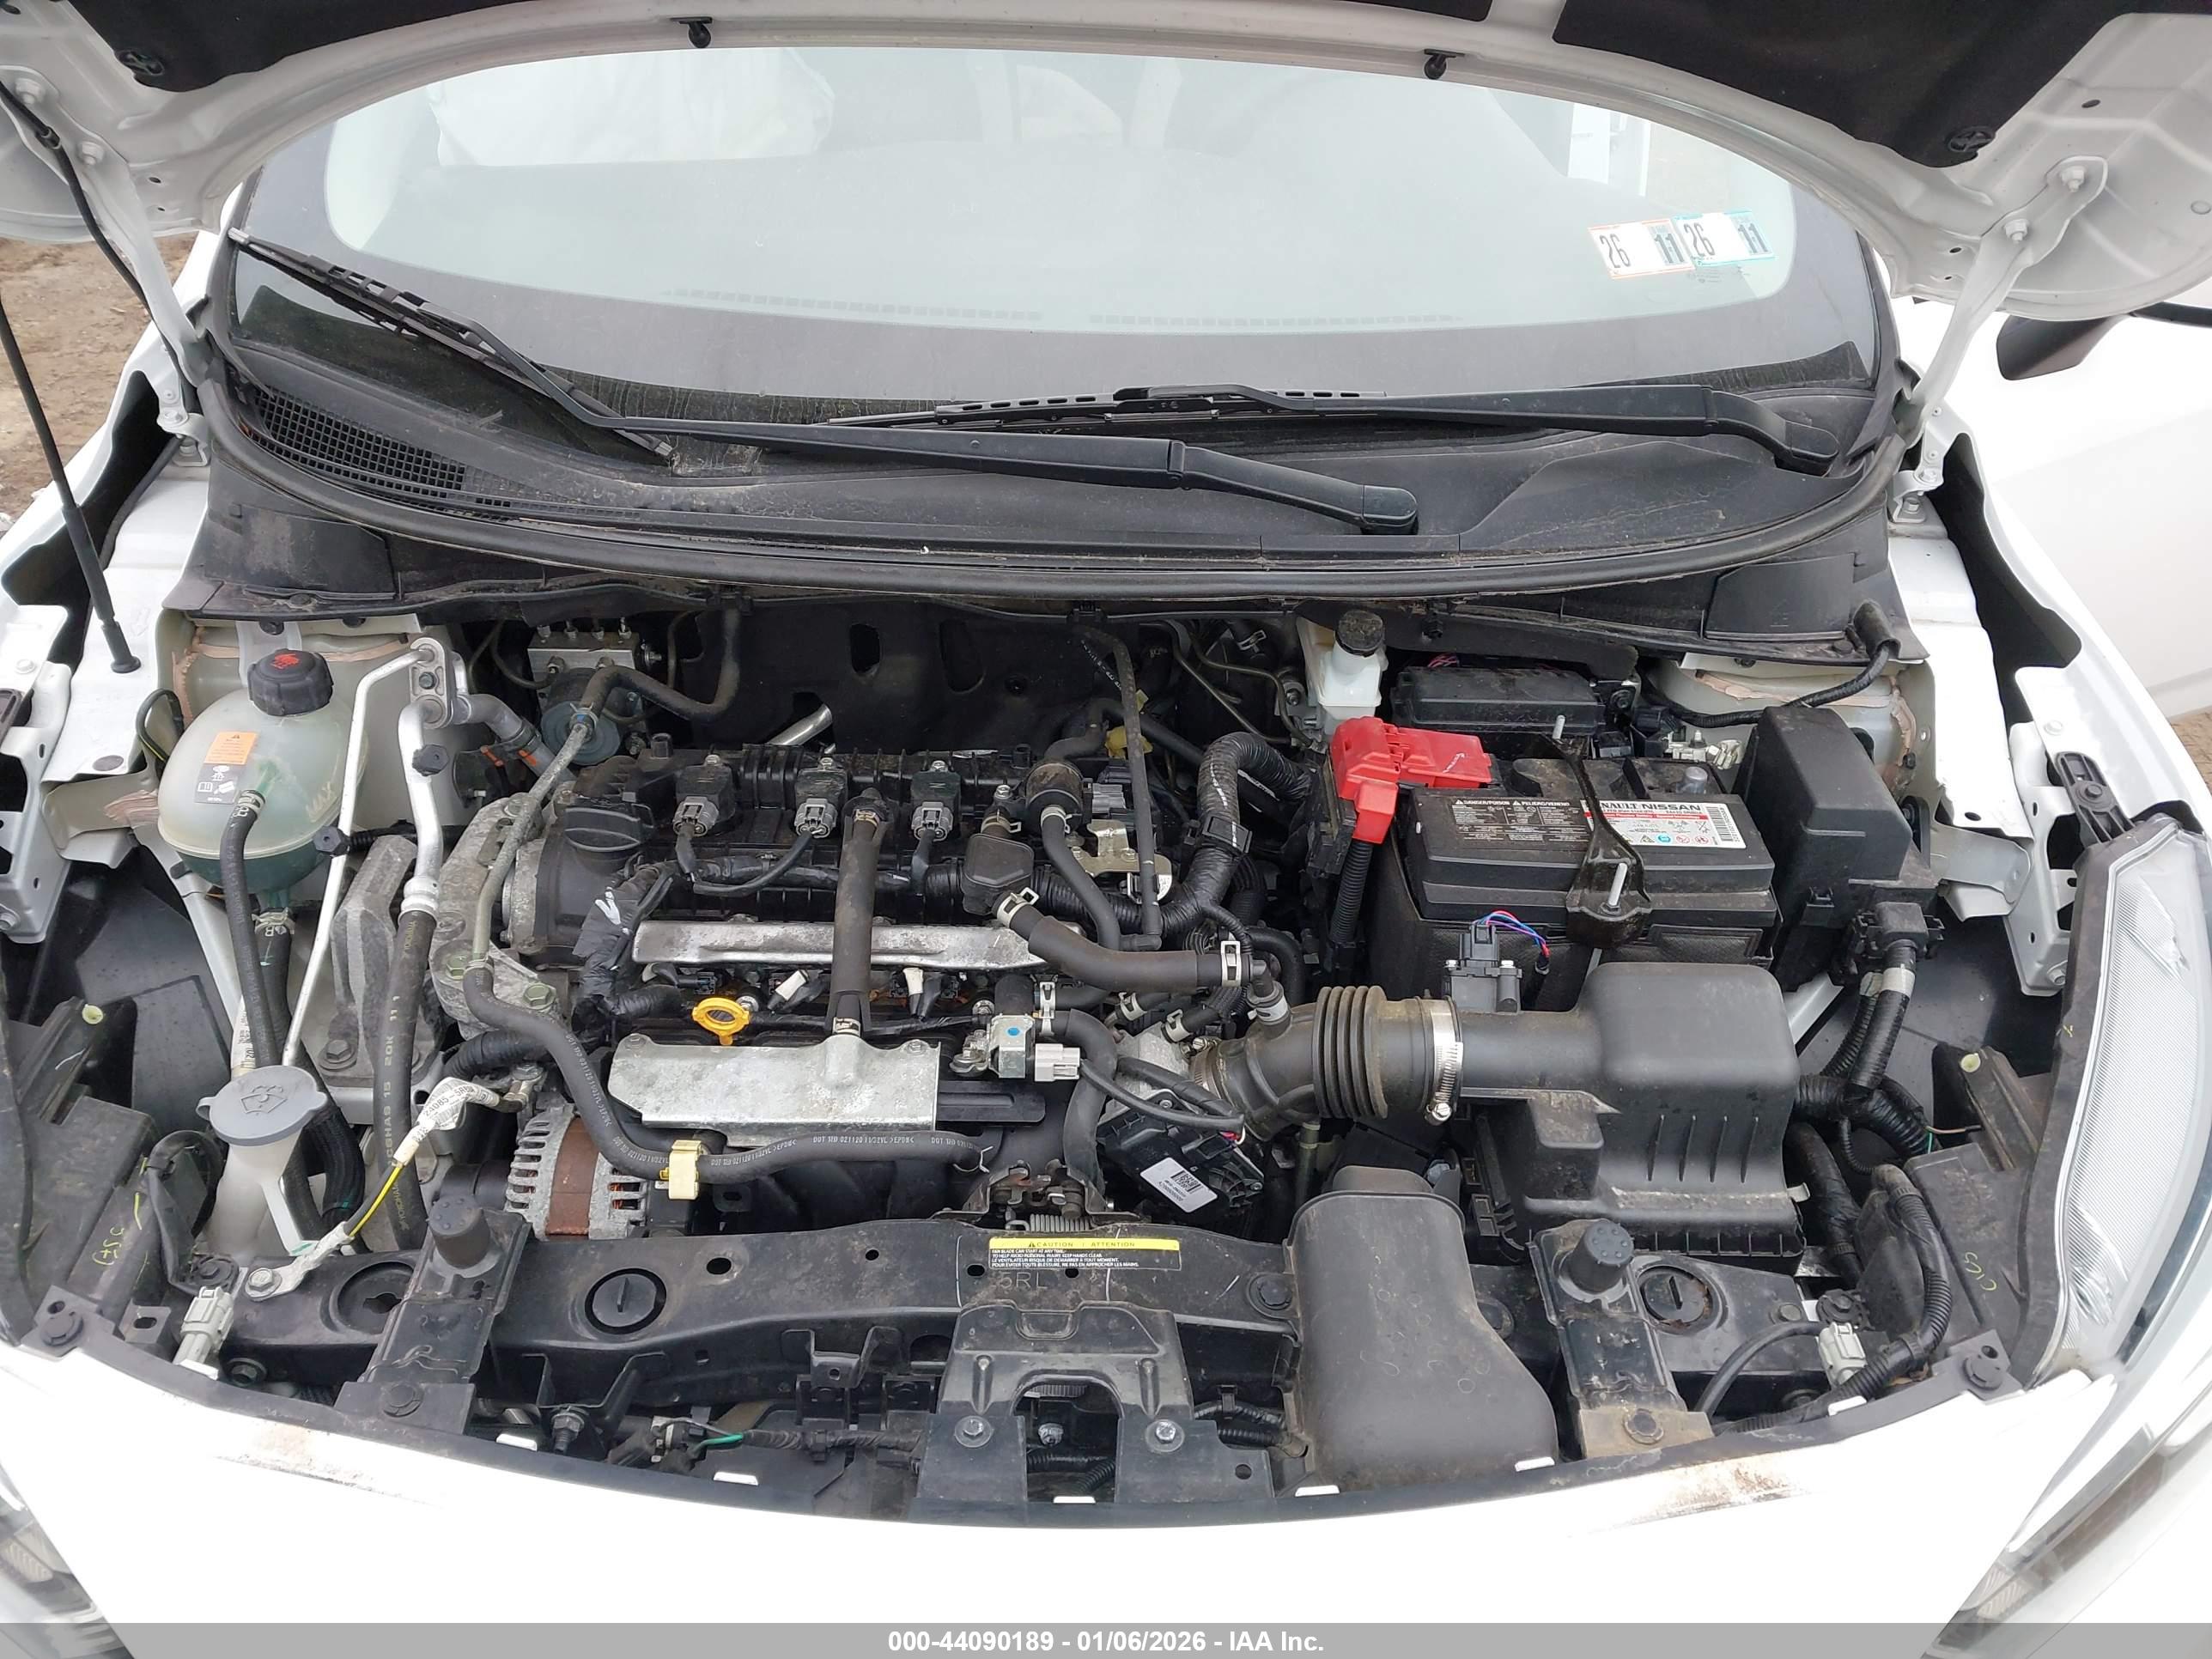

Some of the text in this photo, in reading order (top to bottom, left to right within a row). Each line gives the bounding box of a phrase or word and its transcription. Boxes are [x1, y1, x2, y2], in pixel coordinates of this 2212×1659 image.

[1598, 233, 1686, 269] 26 11
[1683, 222, 1769, 257] 26 11
